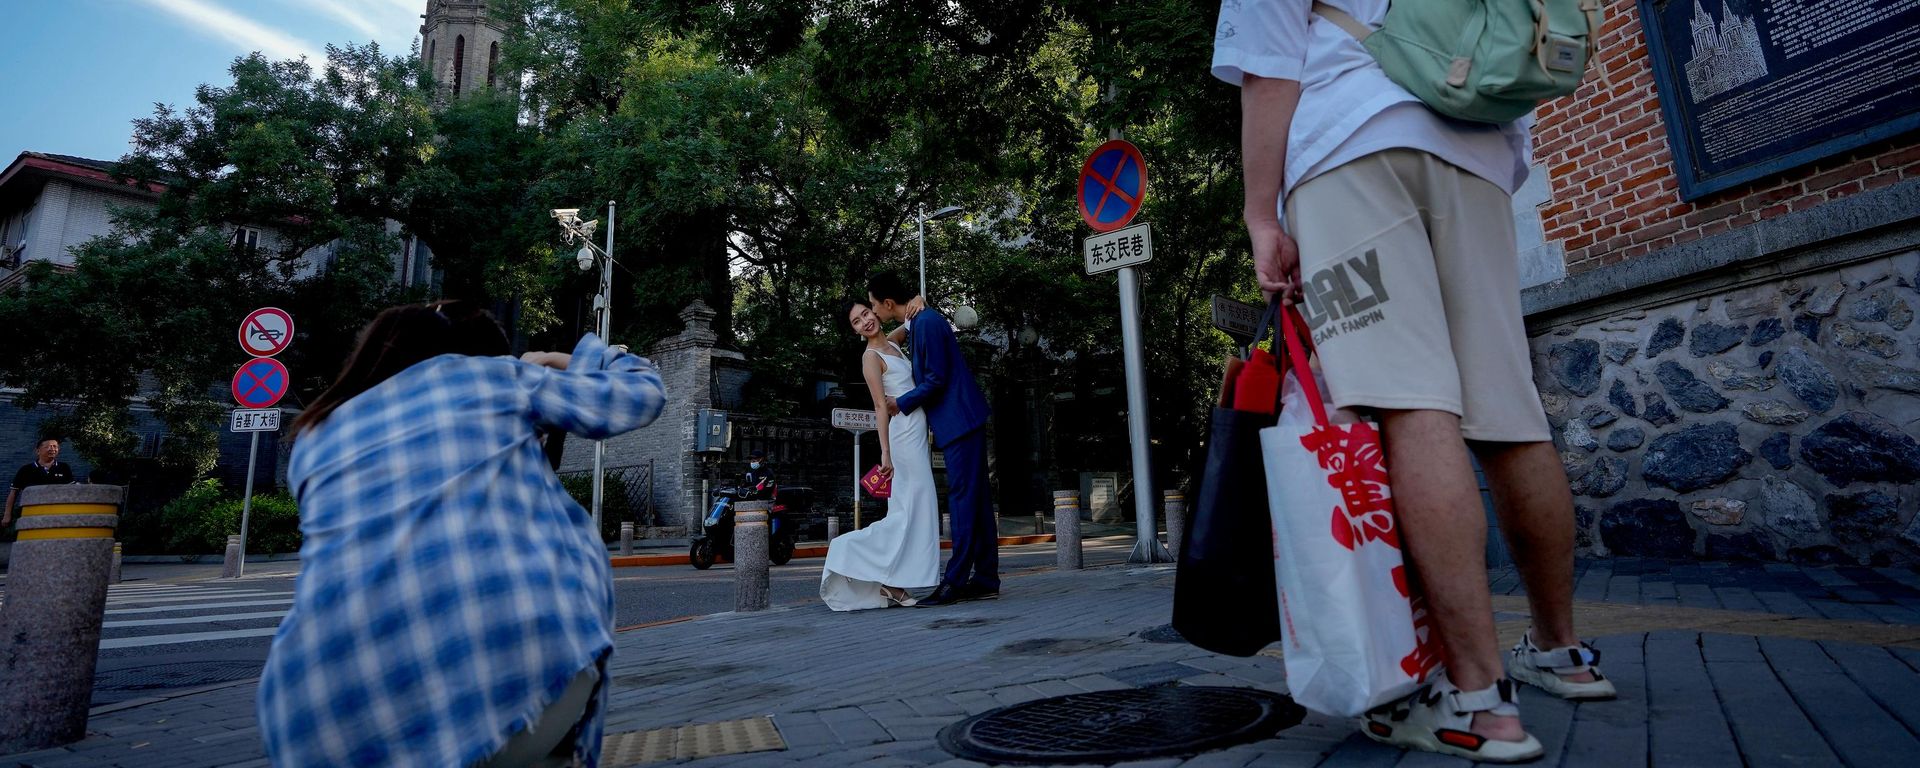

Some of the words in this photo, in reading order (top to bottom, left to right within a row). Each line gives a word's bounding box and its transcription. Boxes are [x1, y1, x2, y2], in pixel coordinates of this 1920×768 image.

[1091, 233, 1143, 265] 东交民巷
[1313, 325, 1339, 345] EAM
[1341, 308, 1385, 334] FANPIN
[235, 412, 277, 428] 台基厂大街
[844, 412, 870, 422] 东交民巷
